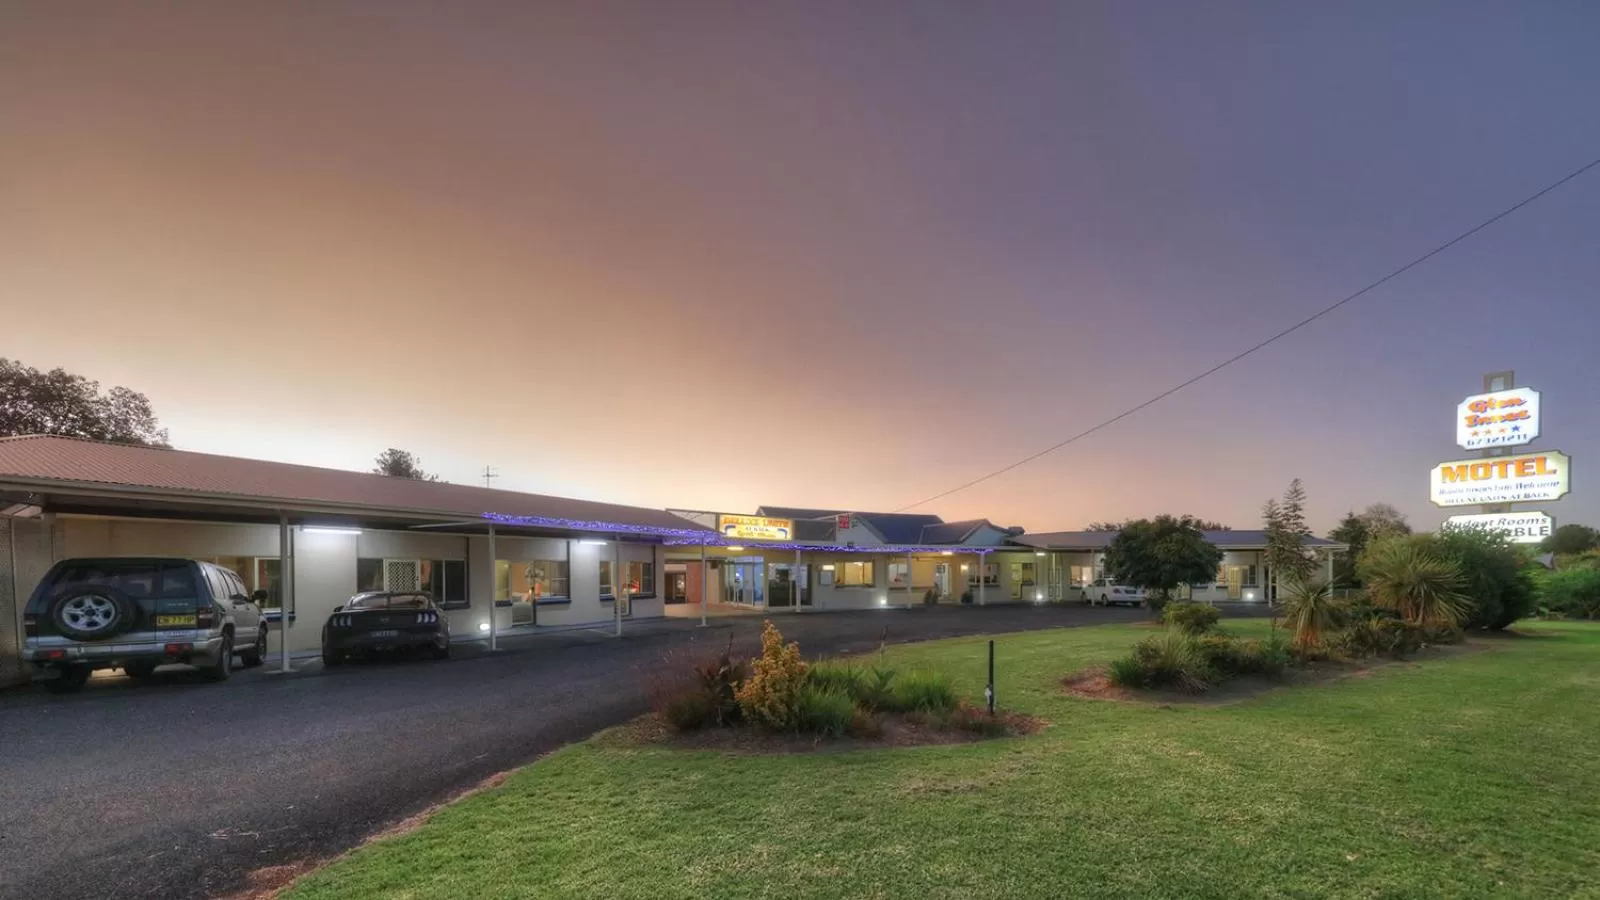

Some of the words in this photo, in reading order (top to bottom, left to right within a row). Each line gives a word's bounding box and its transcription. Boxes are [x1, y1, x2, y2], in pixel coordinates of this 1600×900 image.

[1468, 398, 1527, 413] Glen
[1441, 456, 1557, 483] MOTEL
[1497, 517, 1549, 526] Rooms
